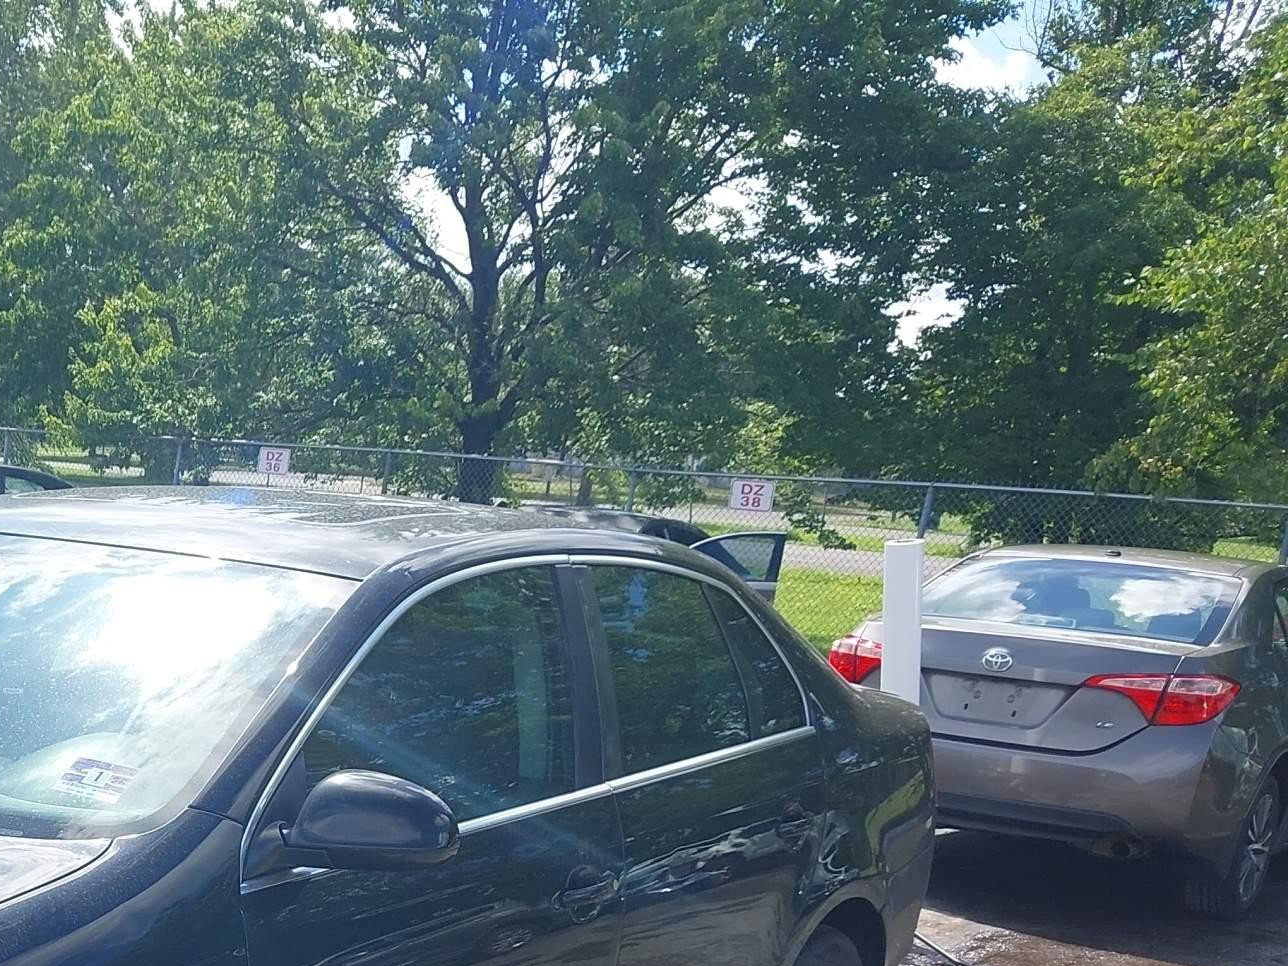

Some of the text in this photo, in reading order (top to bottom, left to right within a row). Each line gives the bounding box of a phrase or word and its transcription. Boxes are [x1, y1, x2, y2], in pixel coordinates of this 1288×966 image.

[266, 451, 283, 462] DZ
[265, 462, 280, 472] 36
[741, 483, 765, 496] DZ
[740, 495, 761, 508] 38
